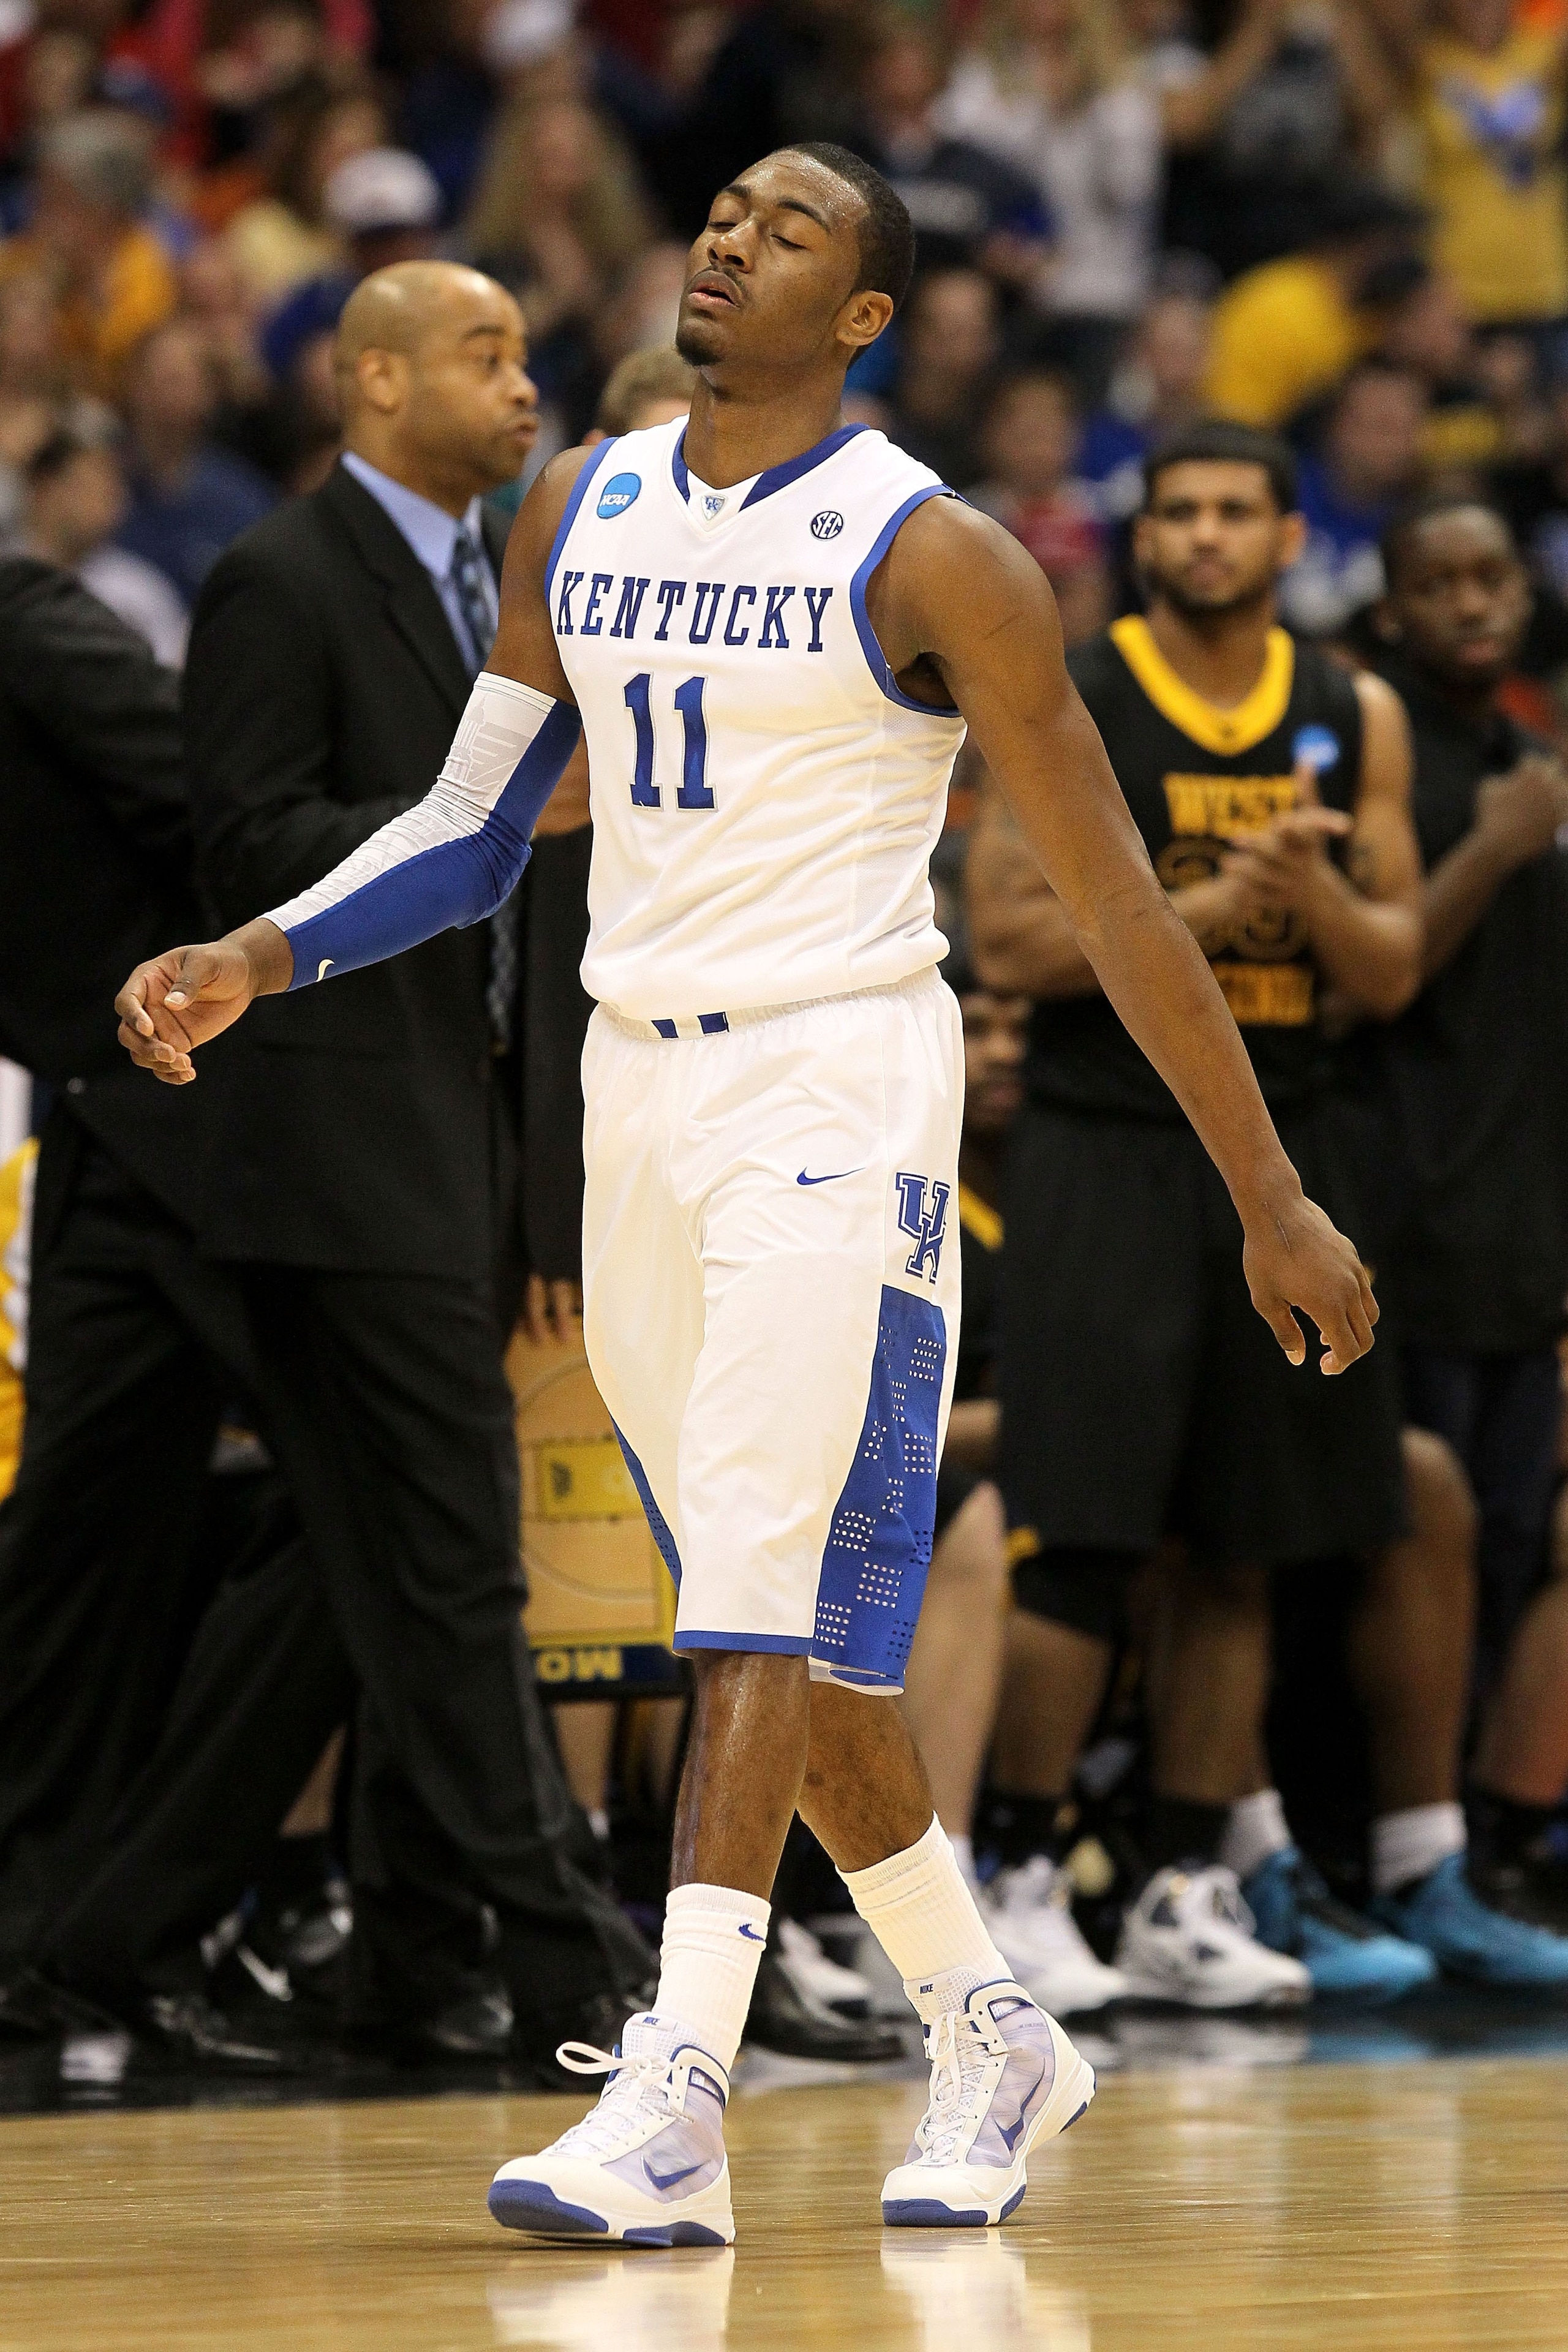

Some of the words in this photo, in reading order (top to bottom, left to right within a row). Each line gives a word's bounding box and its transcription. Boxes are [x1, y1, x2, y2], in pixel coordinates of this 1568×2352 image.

[600, 494, 630, 507] NCAA
[812, 510, 843, 539] SEC
[557, 571, 834, 652] KENTUCKY
[623, 671, 718, 812] 11
[895, 1172, 950, 1284] UK
[920, 1983, 933, 1994] NIKE
[643, 2016, 660, 2026] NIKE
